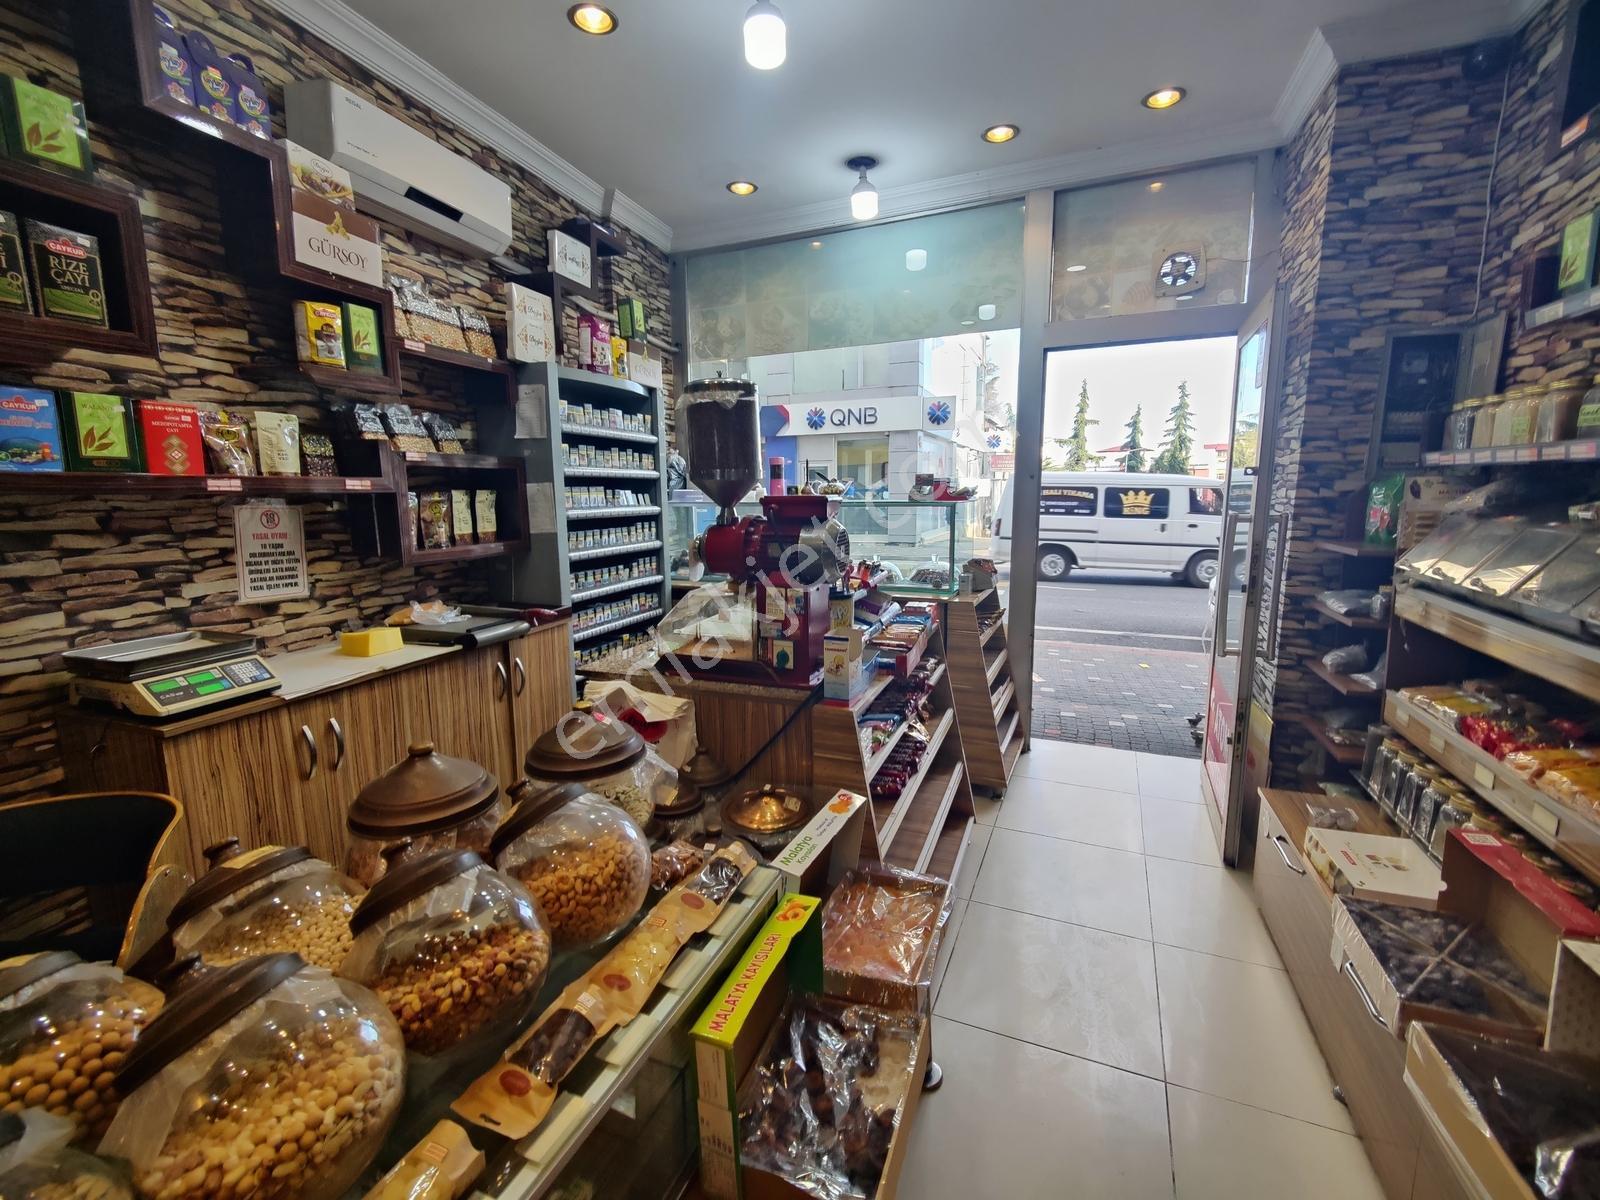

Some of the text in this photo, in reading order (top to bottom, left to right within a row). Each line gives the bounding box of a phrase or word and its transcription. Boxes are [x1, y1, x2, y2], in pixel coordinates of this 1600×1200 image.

[308, 237, 369, 269] GÜRSOY
[830, 407, 878, 426] QNB
[252, 532, 269, 540] YASAL
[780, 835, 813, 866] Malatya
[708, 982, 750, 1033] MALATYA
[741, 933, 782, 981] KAYISILARI
